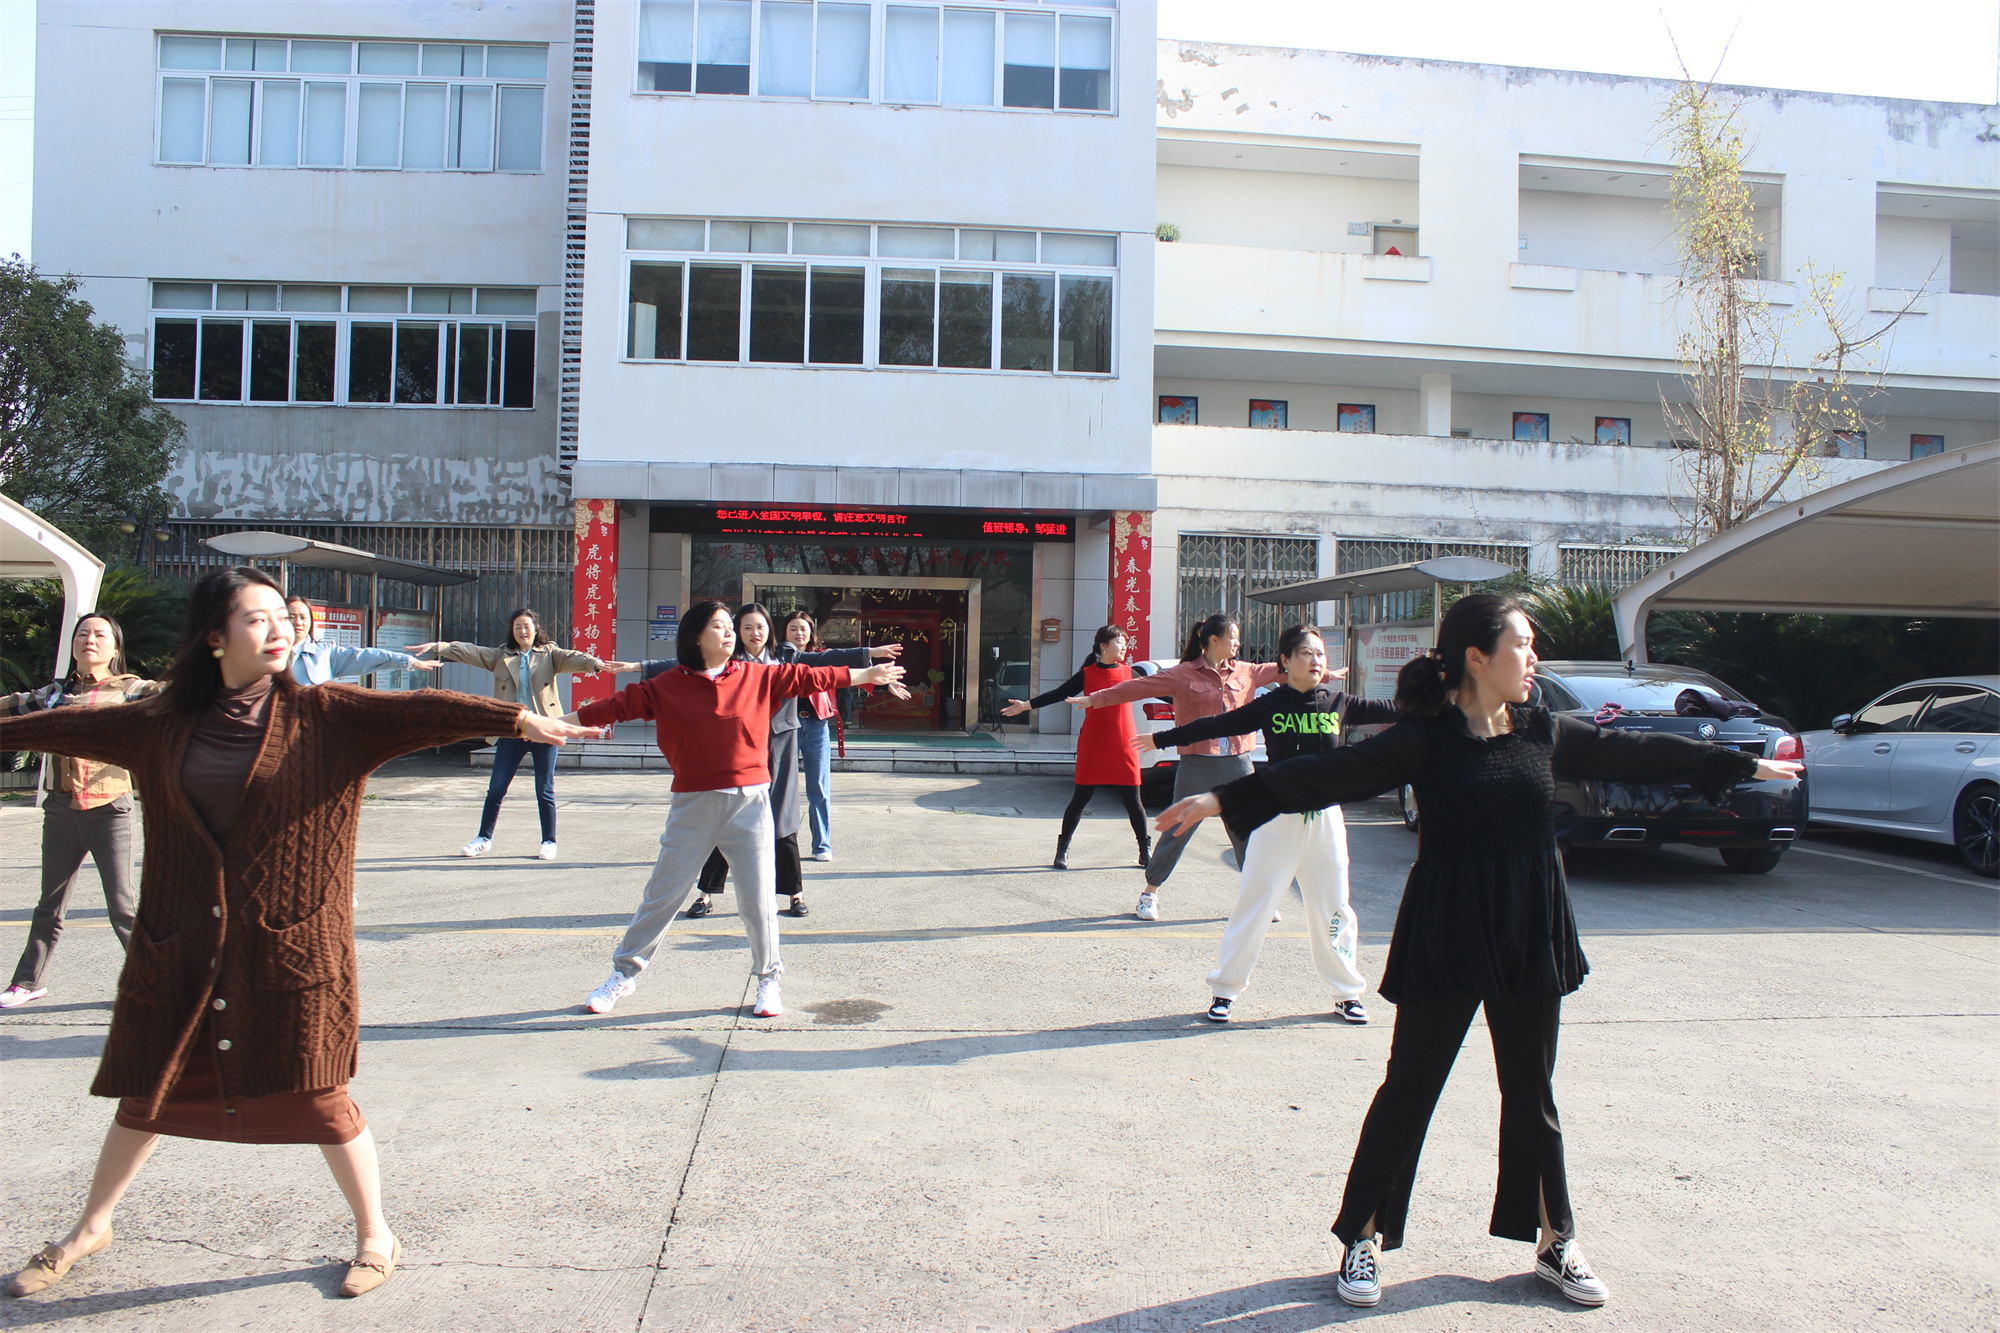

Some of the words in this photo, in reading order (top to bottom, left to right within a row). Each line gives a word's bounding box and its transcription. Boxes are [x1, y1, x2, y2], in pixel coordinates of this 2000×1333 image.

[714, 542, 801, 563] 艰苦奋斗
[820, 544, 905, 567] 追求卓越
[925, 549, 1012, 568] 服务人民
[1271, 711, 1341, 736] SAYLESS
[1329, 911, 1342, 938] JUST
